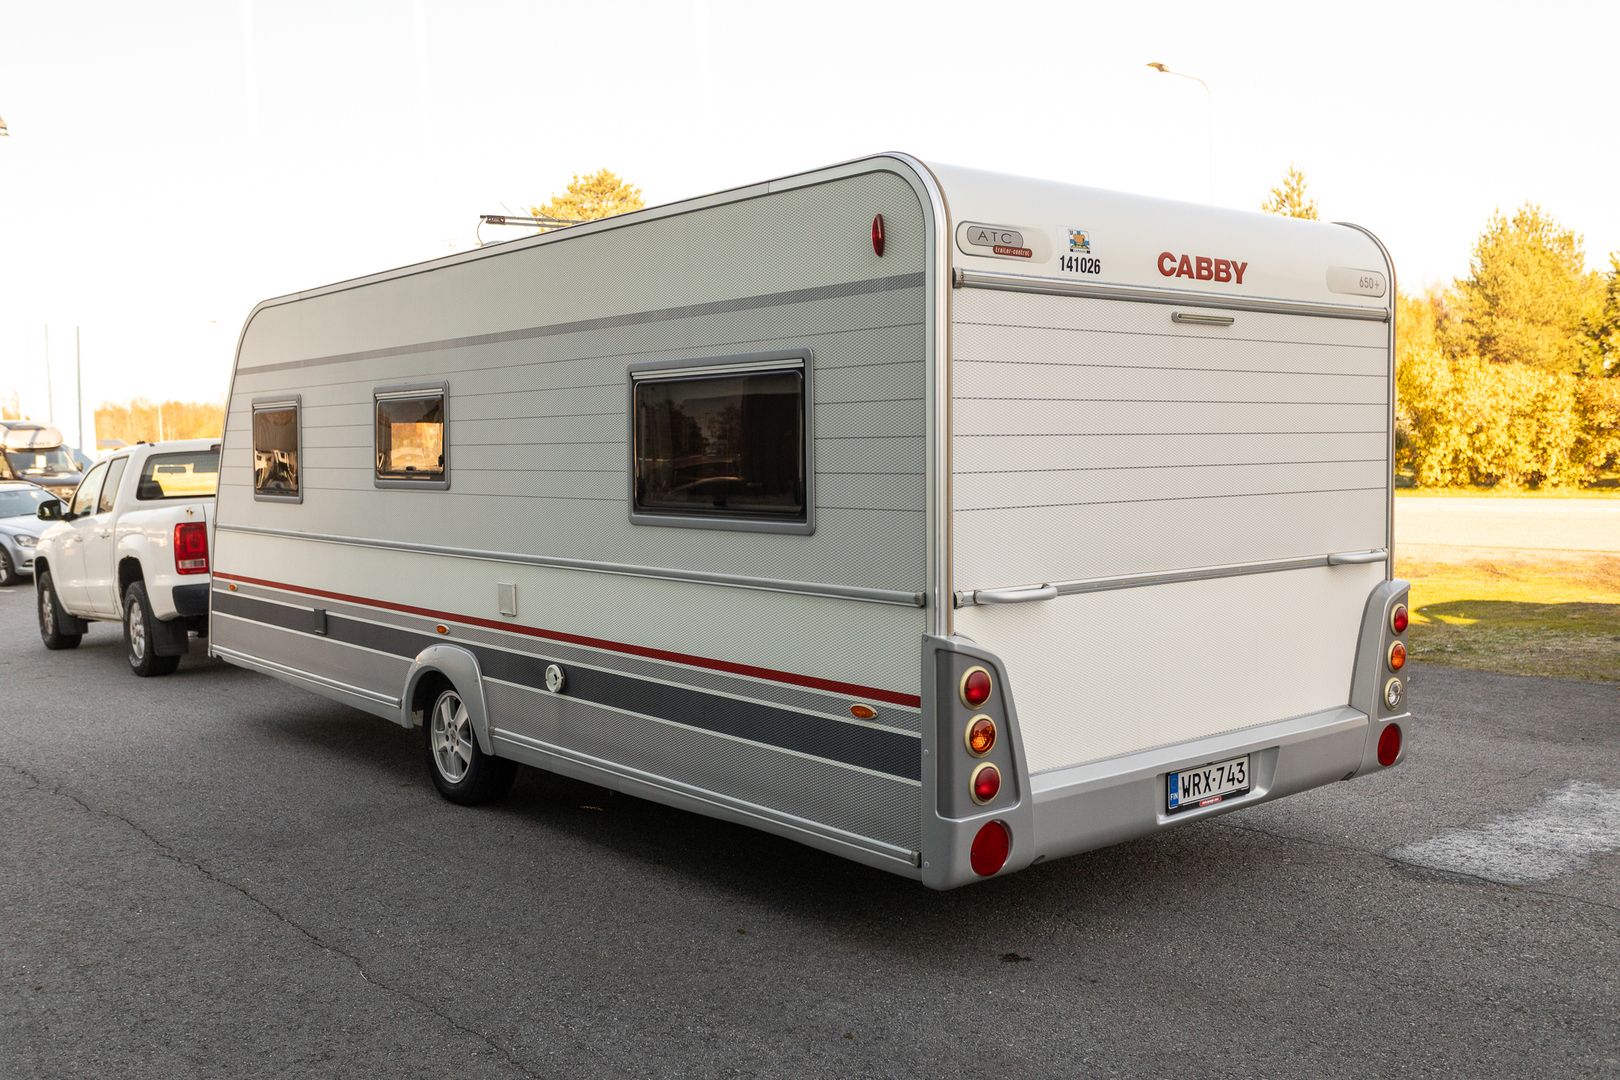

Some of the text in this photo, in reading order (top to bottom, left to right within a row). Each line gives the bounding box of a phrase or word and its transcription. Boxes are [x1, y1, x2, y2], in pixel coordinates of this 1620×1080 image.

[977, 230, 1012, 244] ATC
[1060, 255, 1101, 275] 141026
[1157, 251, 1248, 285] CABBY
[1359, 276, 1380, 289] 650+
[1181, 761, 1246, 799] WRX-743
[1170, 793, 1179, 801] FIN
